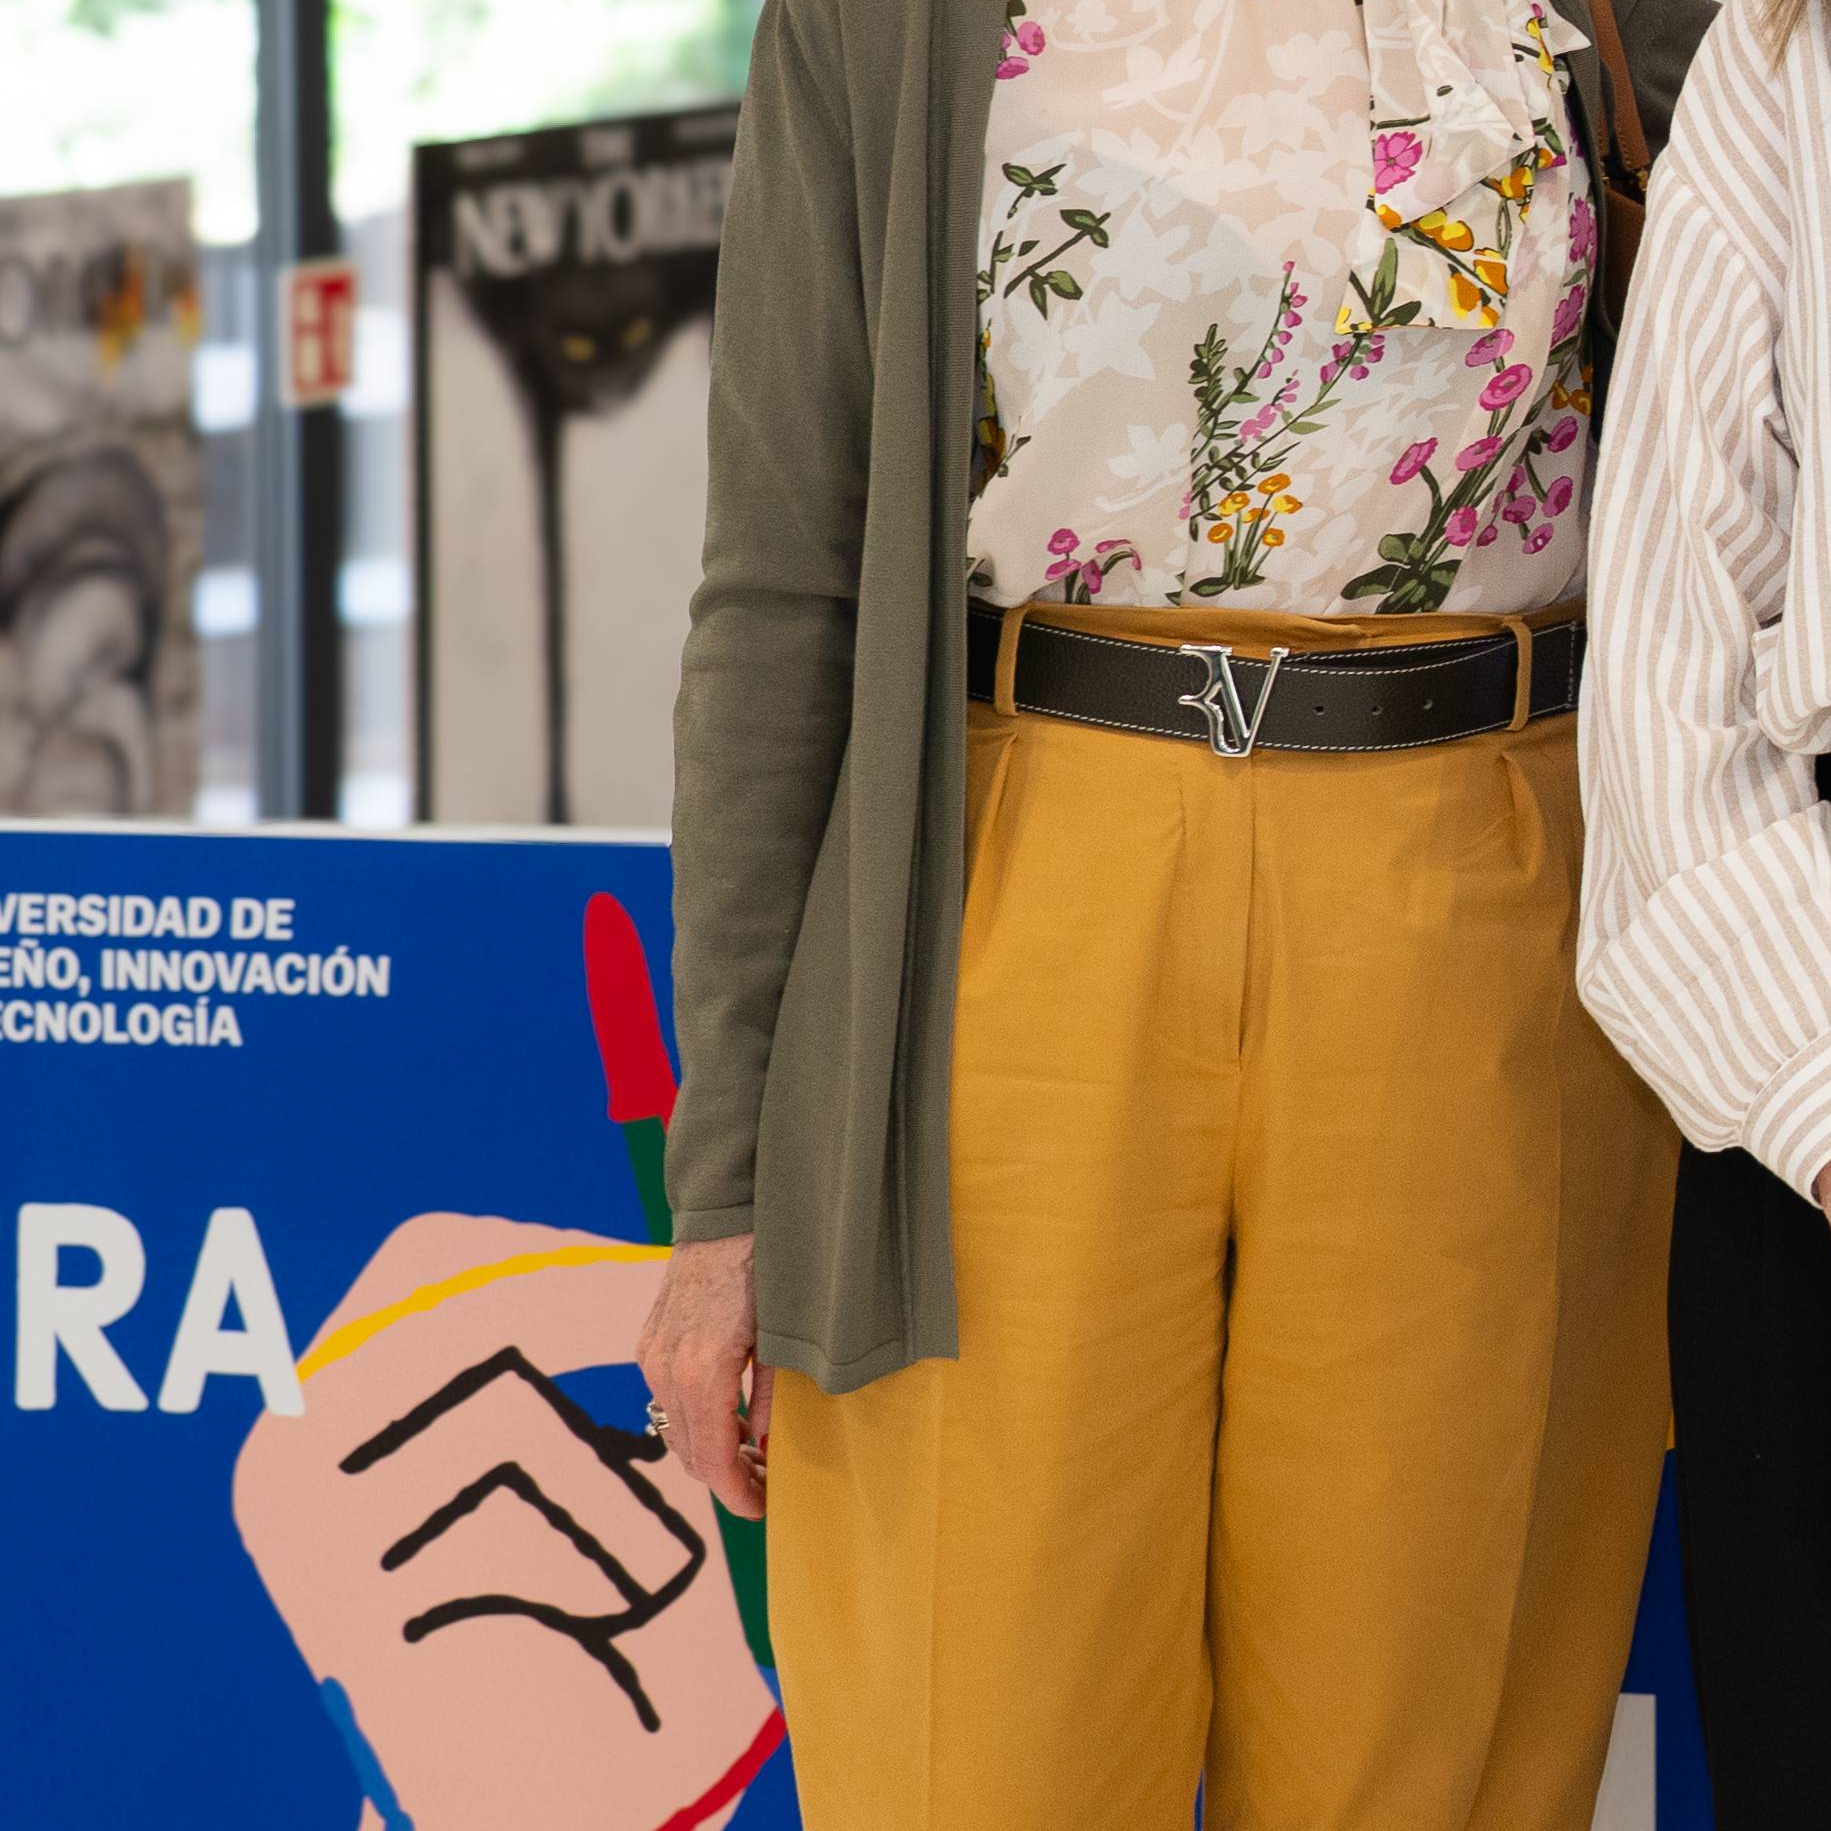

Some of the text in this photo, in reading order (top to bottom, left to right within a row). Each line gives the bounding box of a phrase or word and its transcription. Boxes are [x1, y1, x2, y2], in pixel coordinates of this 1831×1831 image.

[230, 898, 295, 941] DE
[101, 945, 391, 998] INNOVACIÓN
[0, 997, 244, 1047] CNOLOGÍA
[14, 1202, 306, 1417] RA
